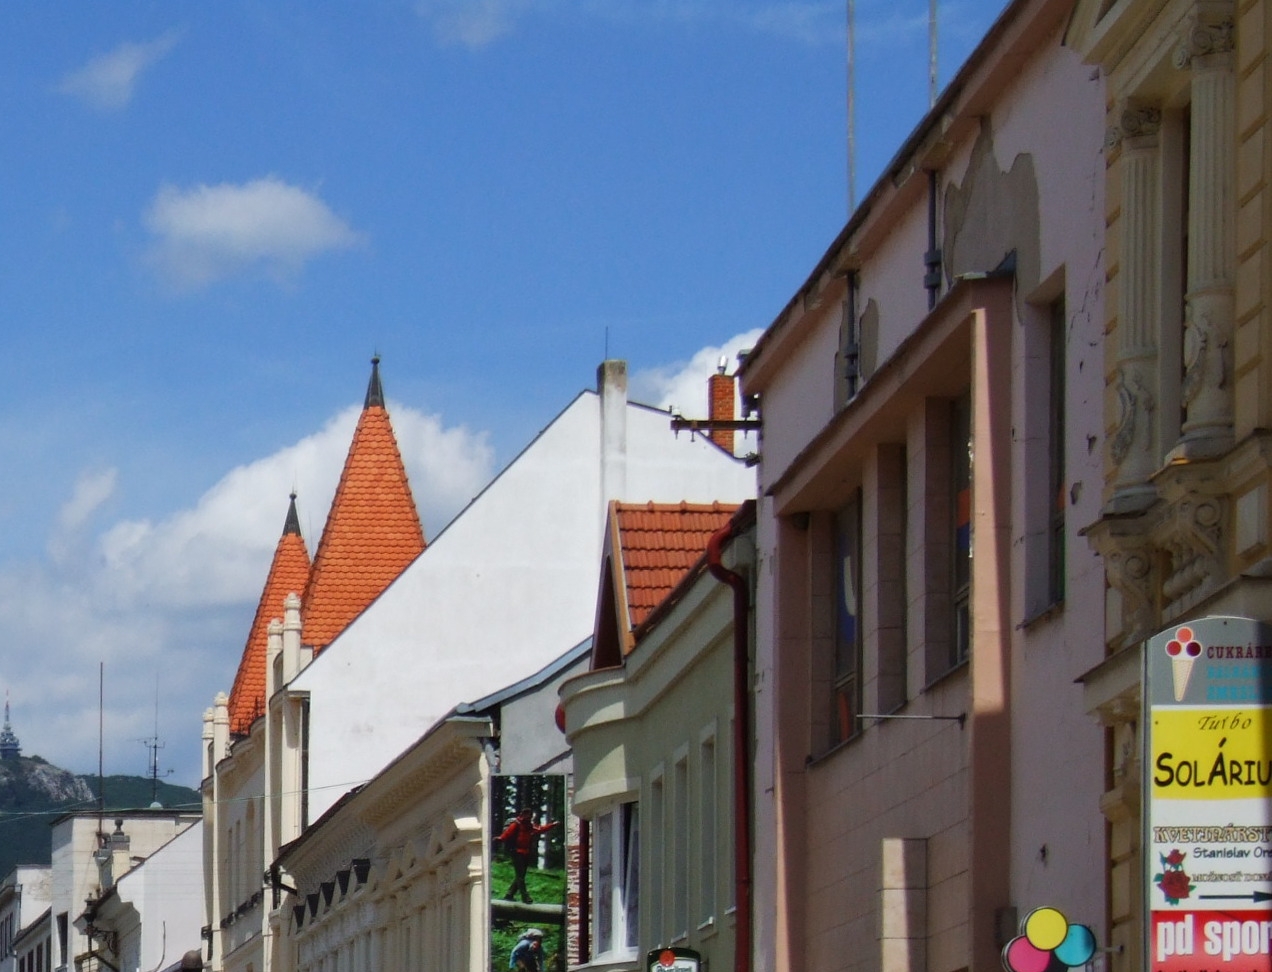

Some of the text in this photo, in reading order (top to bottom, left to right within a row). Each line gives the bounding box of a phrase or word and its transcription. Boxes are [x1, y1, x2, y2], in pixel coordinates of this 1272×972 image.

[1198, 712, 1252, 731] Turbo
[1193, 847, 1250, 859] Stanislav
[1156, 914, 1195, 962] pd
